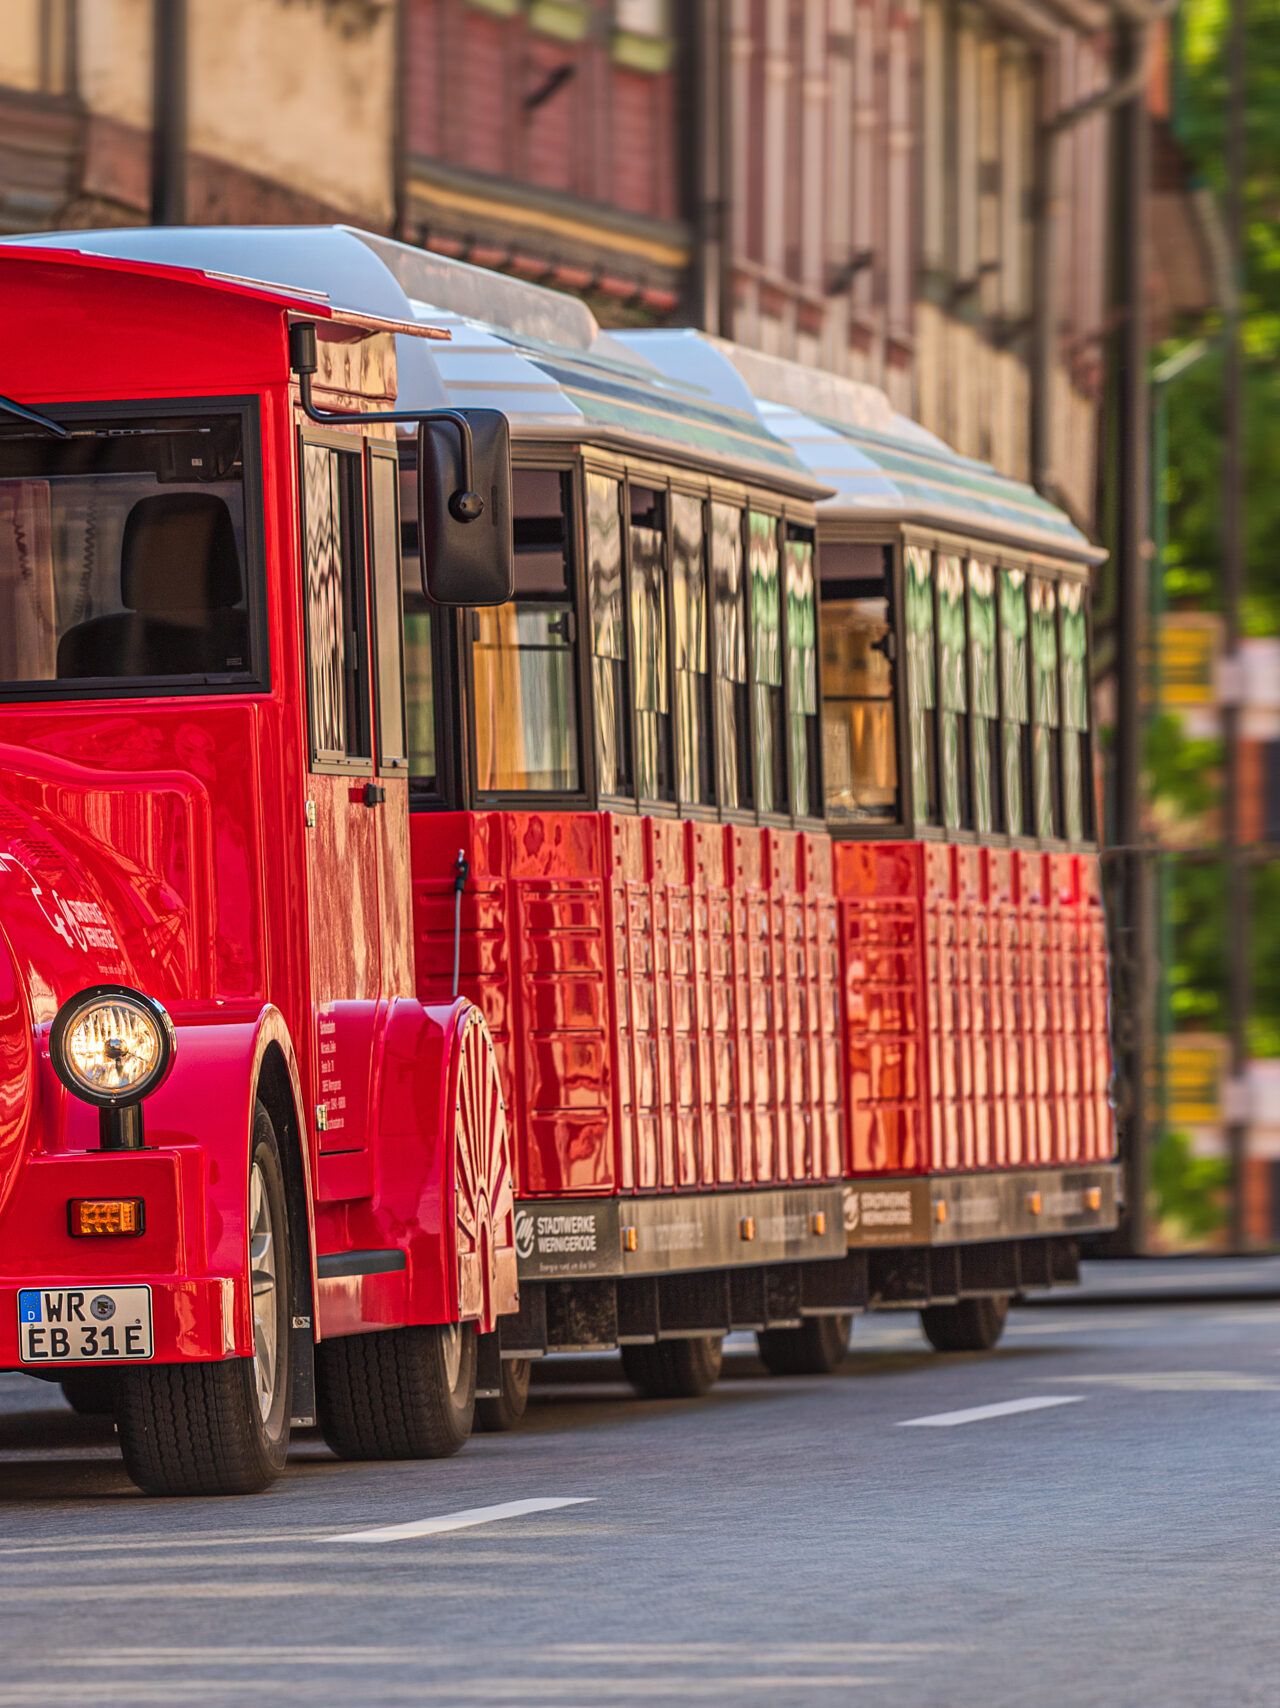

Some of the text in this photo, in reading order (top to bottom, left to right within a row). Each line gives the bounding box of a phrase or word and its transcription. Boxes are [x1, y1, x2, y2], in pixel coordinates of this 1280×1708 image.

[537, 1215, 596, 1235] STADTWERKE
[538, 1235, 597, 1253] WERNIGERODE
[28, 1310, 35, 1320] D
[44, 1292, 86, 1322] WR
[29, 1328, 71, 1357] EB
